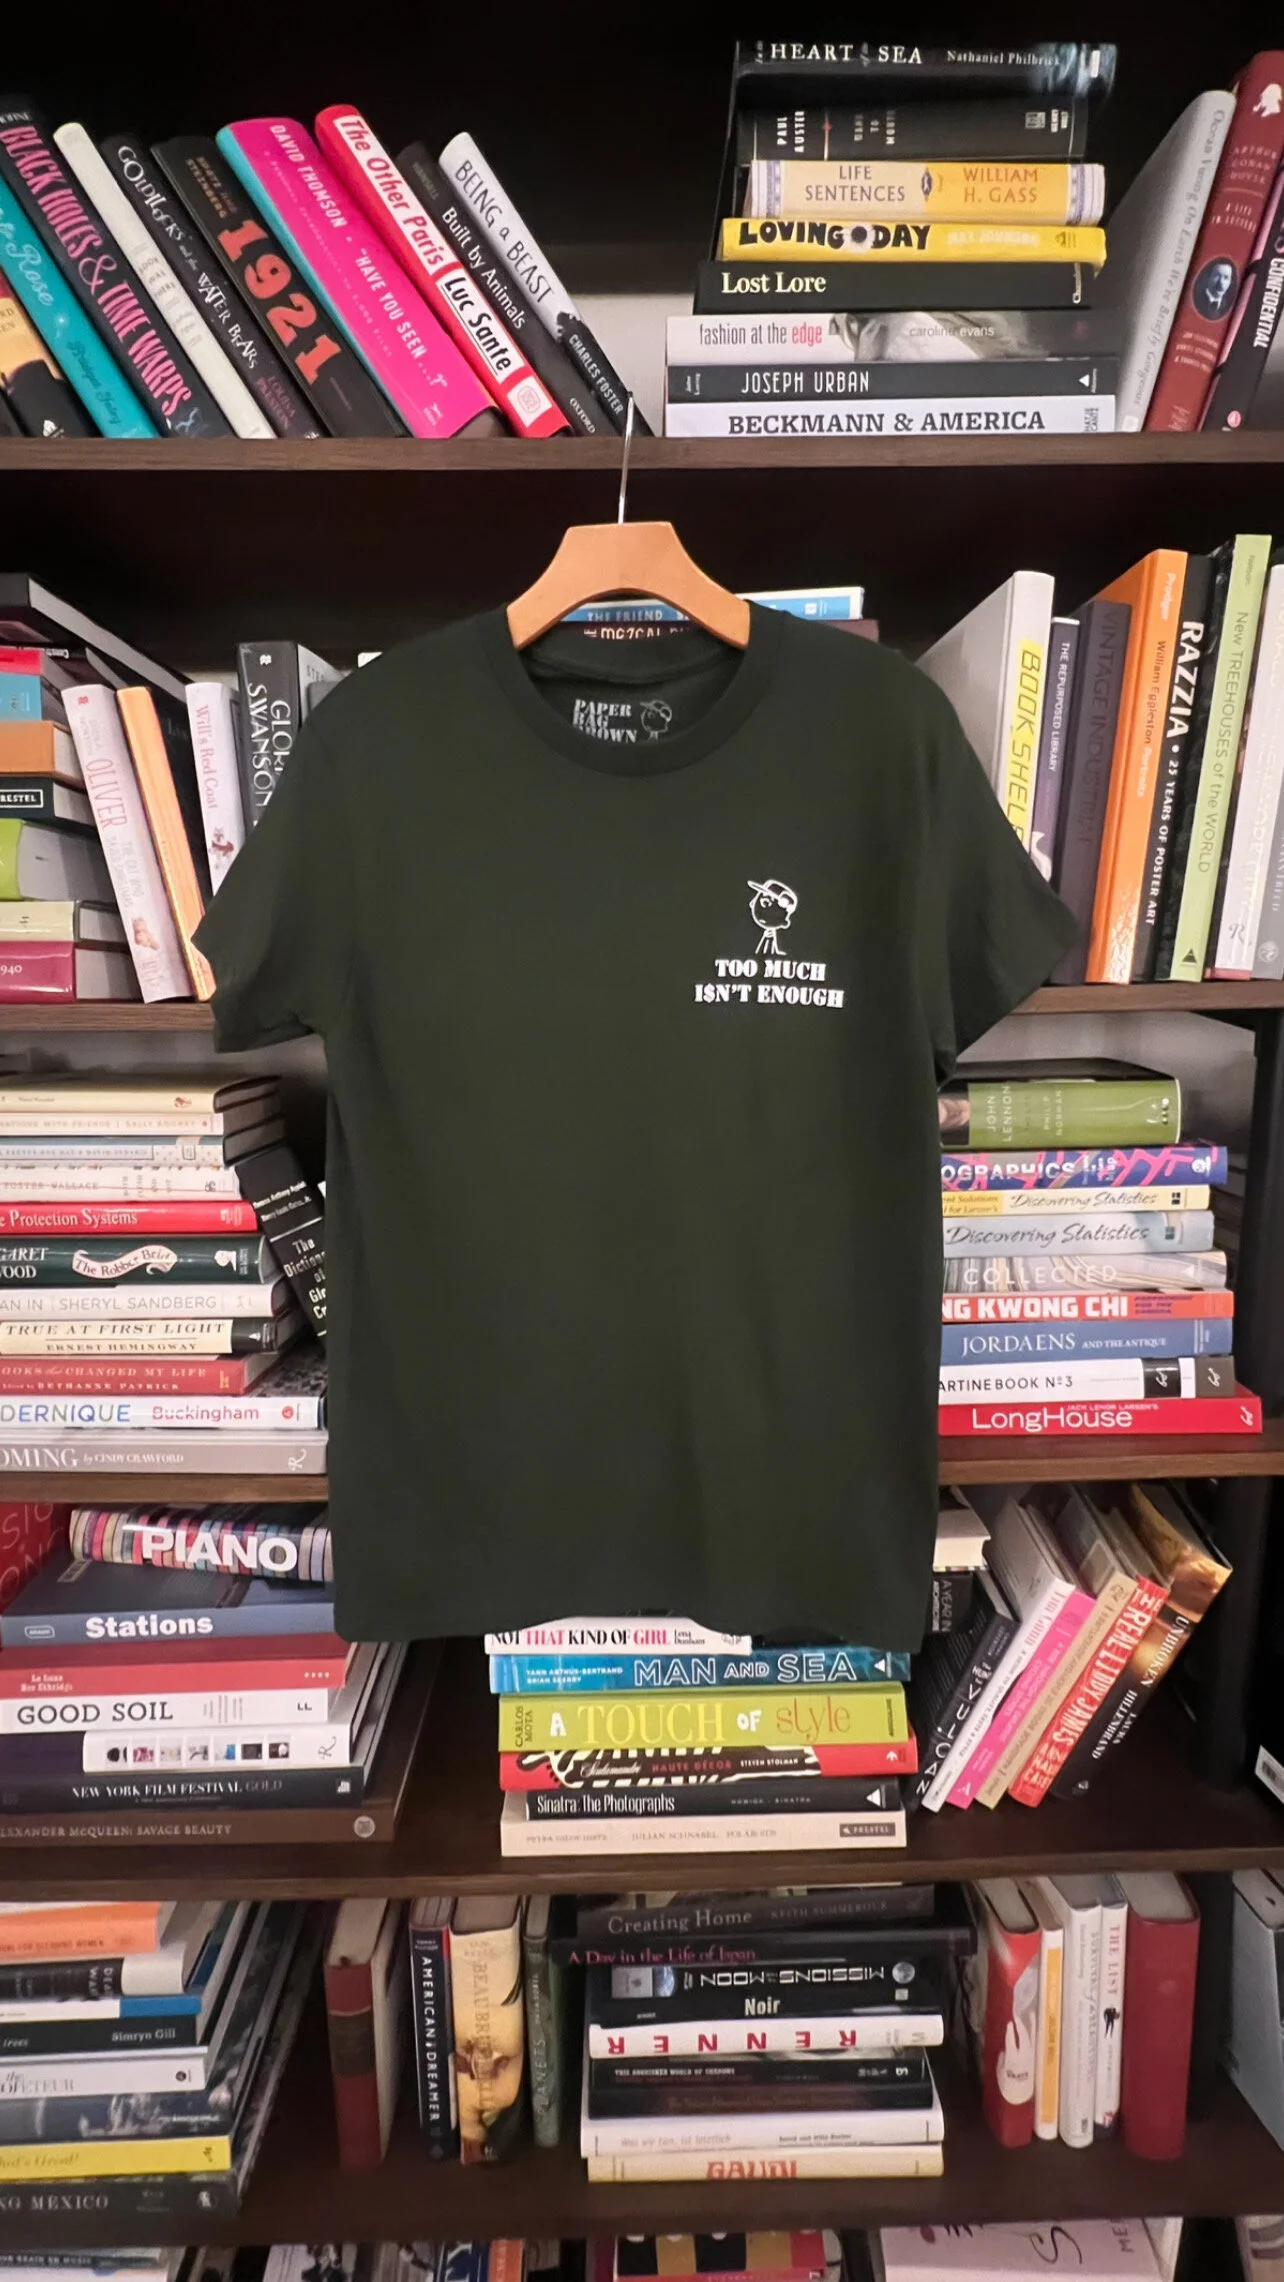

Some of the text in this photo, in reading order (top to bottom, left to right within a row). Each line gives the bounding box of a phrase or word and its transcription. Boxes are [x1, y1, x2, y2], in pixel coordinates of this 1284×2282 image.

[770, 43, 853, 61] HEART
[878, 45, 921, 64] SEA
[947, 50, 1004, 64] Nathaniel
[1, 126, 66, 196] BLACK
[838, 165, 873, 181] LIFE
[270, 124, 348, 228] DAVID THOMSON
[962, 167, 1039, 183] WILLIAM
[341, 119, 447, 267] The Other Paris
[805, 185, 906, 202] SENTENCES
[988, 187, 1038, 203] GASS
[38, 188, 103, 258] HOLES
[455, 159, 557, 304] BEING BEAST
[738, 220, 845, 250] LOVING
[22, 243, 54, 306] Rose
[79, 255, 117, 295] &
[441, 206, 526, 330] Built by Animals
[721, 272, 827, 293] Lost Lore
[97, 281, 151, 342] TIME
[217, 220, 341, 386] 1921
[379, 288, 404, 321] YOU
[1253, 258, 1284, 349] CONFIDENTIAL
[198, 272, 258, 370] WATER BEARS
[444, 276, 512, 371] Luc Sante
[959, 326, 995, 337] evans
[699, 322, 823, 346] fashion at the edge
[127, 330, 191, 416] WARPS
[568, 333, 625, 416] CHARLES FOSTER
[741, 371, 870, 394] JOSEPH URBAN
[569, 397, 596, 435] OXFORD
[728, 411, 1046, 435] BECKMANN & AMERICA
[615, 609, 663, 622] FRIEND
[1016, 650, 1041, 735] BOOK
[574, 699, 633, 717] PAPER
[1048, 641, 1071, 772] THE REPURPOSED LIBRARY
[1137, 640, 1166, 798] William Eggleston Portraits
[572, 712, 609, 729] BAG
[249, 683, 273, 807] SWANSON
[1198, 612, 1248, 873] New TREEHOUSES of the WORLD
[200, 748, 219, 809] Red Coat
[1145, 621, 1204, 925] RAZZIA 25 YEARS OF POSTER ART
[86, 758, 128, 830] OLIVER
[715, 959, 826, 981] TOO MUCH
[757, 985, 844, 1008] ENOUGH
[987, 1095, 997, 1132] JOHN
[1002, 1085, 1013, 1141] LENNON
[1010, 1192, 1158, 1209] Discovering Statistics
[9, 1208, 138, 1228] Protection Systems
[292, 1238, 315, 1255] The
[945, 1222, 1150, 1248] Discovering Statistics
[75, 1257, 97, 1275] The
[963, 1265, 1118, 1286] COLLECTED
[28, 1296, 217, 1311] IN SHERYL SANDBERG
[977, 1297, 1079, 1319] KWONG
[1085, 1296, 1128, 1317] CHI
[6, 1323, 225, 1335] TRUE AT FIRST LIGHT
[46, 1343, 197, 1351] ERNEST HEMINGWAY
[962, 1333, 1167, 1356] JORDAENS AND ANTIQUE
[64, 1367, 207, 1377] CHANGED LIFE
[995, 1378, 1039, 1391] BOOK
[152, 1406, 260, 1423] Buckingham
[972, 1406, 1133, 1433] LongHouse
[142, 1529, 297, 1572] PIANO
[85, 1614, 214, 1639] Stations
[526, 1629, 671, 1645] THAT KIND OF GIRL
[1141, 1616, 1190, 1688] UNBROKEN
[634, 1652, 857, 1687] MAN AND SEA
[1052, 1606, 1151, 1745] REAL JAMES
[18, 1702, 174, 1725] GOOD SOIL
[515, 1705, 524, 1747] CARLOS
[524, 1710, 533, 1742] MOTA
[550, 1697, 851, 1745] A TOUCH OF style
[1092, 1690, 1138, 1760] HILLENBRAND
[652, 1762, 690, 1773] HAUTE
[72, 1781, 243, 1799] NEW YORK FILM FESTIVAL
[603, 1793, 675, 1815] Photographs
[137, 1824, 232, 1837] SAVAGE BEAUTY
[608, 1915, 689, 1934] Creating
[695, 1909, 752, 1928] Home
[620, 1948, 696, 1962] in the Life
[701, 1967, 884, 1986] MISSIONS MOON
[745, 1997, 780, 2016] Noir
[156, 2028, 176, 2040] Gill
[421, 1956, 440, 2121] AMERICAN DREAMER
[31, 2195, 108, 2210] MEXICO
